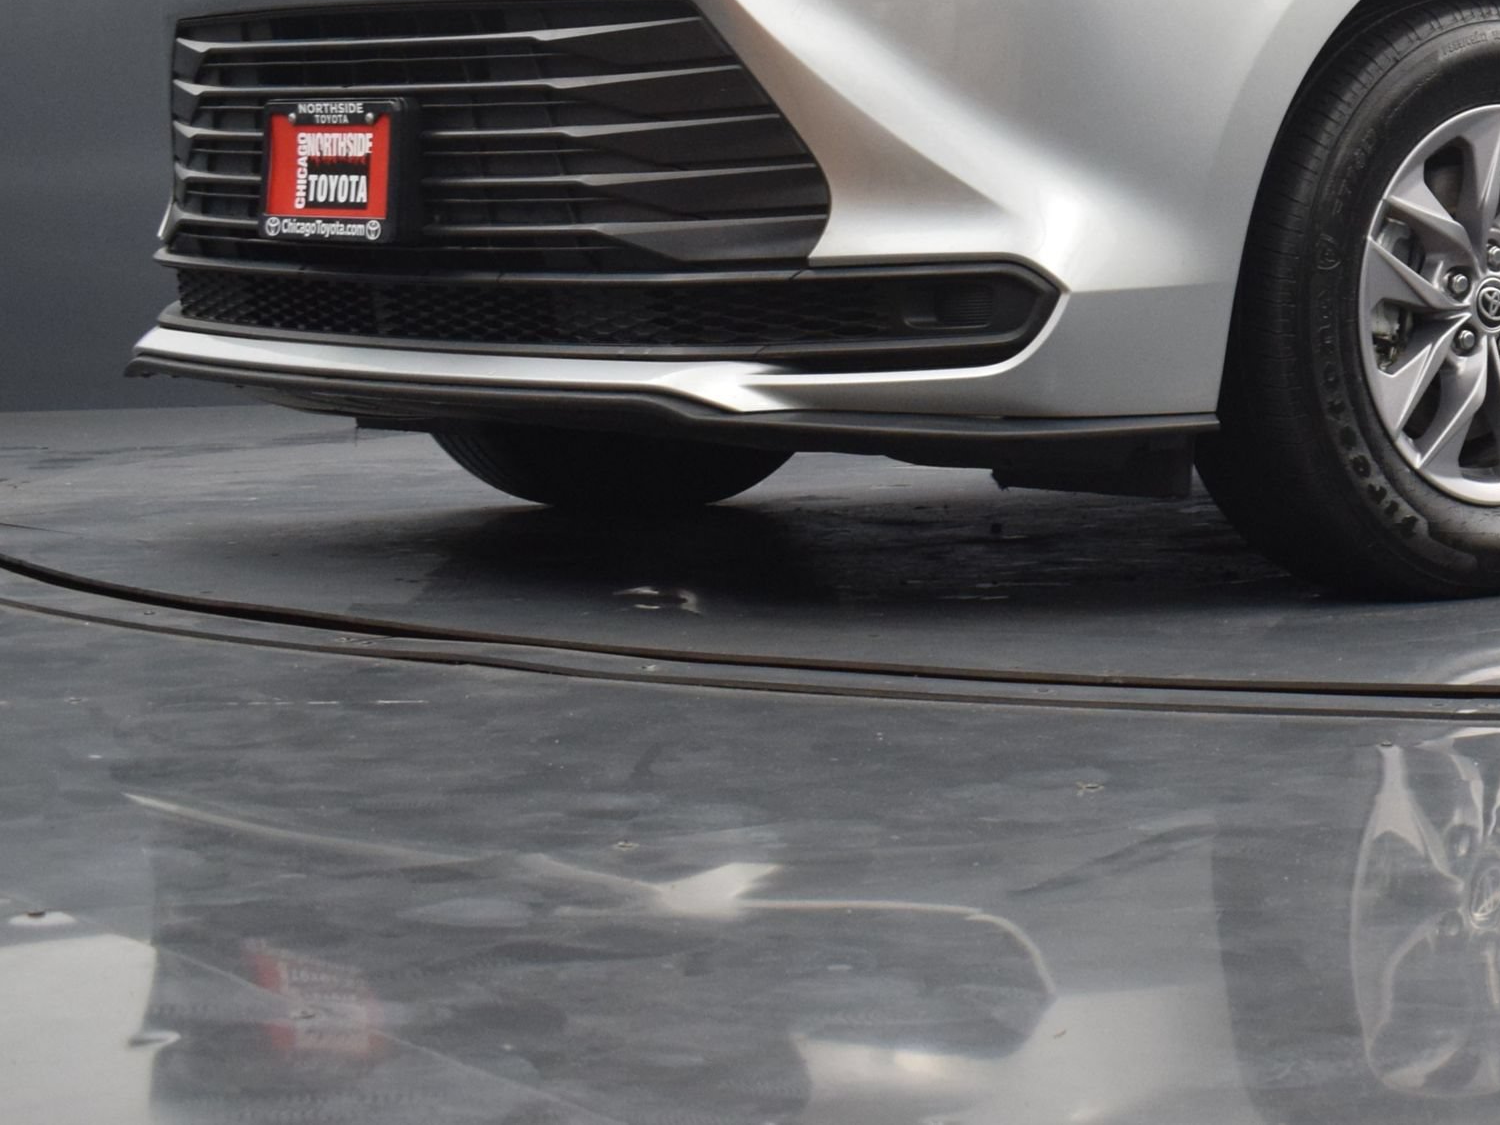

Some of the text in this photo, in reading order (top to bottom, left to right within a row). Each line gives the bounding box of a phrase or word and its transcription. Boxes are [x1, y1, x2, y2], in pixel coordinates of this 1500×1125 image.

[299, 103, 364, 114] NORTHSIDE
[315, 114, 349, 124] TOYOTA
[308, 133, 373, 157] NORTHSIDE
[294, 132, 308, 209] CHICAGO
[308, 174, 368, 203] TOYOTA
[281, 219, 365, 237] ChicagoToyota.com
